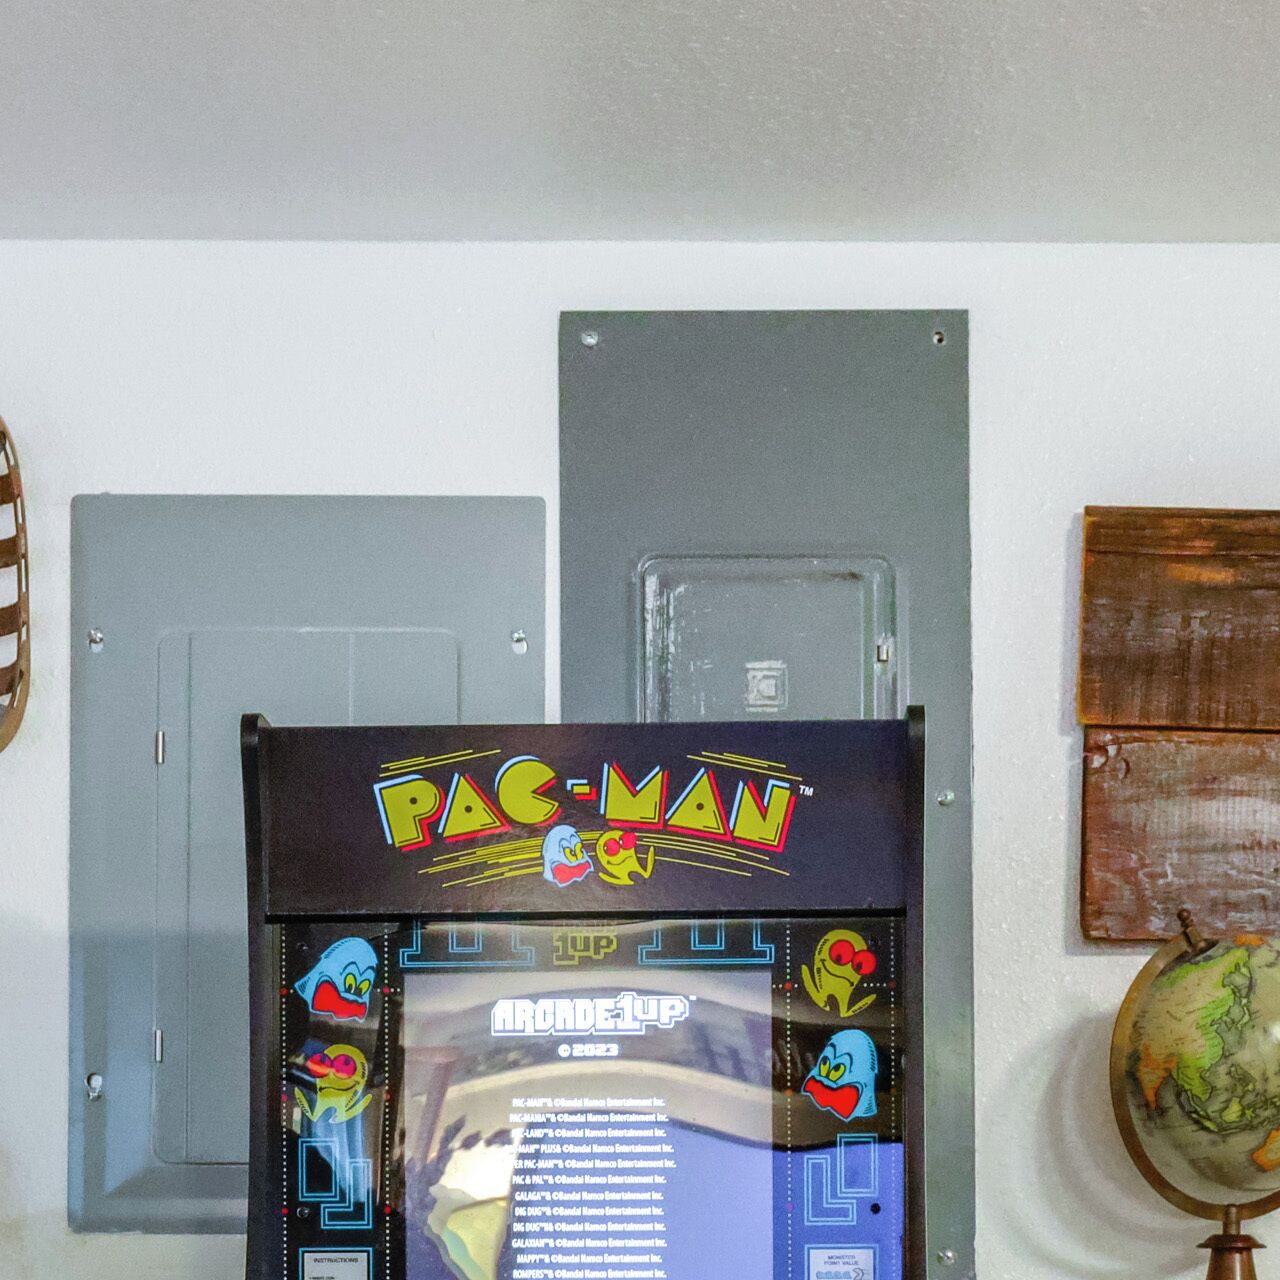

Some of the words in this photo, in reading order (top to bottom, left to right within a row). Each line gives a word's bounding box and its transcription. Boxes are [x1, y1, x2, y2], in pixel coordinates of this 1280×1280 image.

[373, 754, 797, 853] PAC-MAN
[572, 1044, 619, 1057] 2023
[584, 1098, 605, 1107] Namco
[607, 1097, 652, 1106] Entertainment
[587, 1113, 609, 1122] Namco
[610, 1112, 656, 1121] Entertainment
[585, 1128, 607, 1137] Namco
[608, 1127, 653, 1136] Entertainment
[593, 1144, 614, 1153] Namco
[615, 1143, 661, 1152] Entertainment
[595, 1159, 617, 1168] Namco
[618, 1158, 663, 1167] Entertainment
[585, 1175, 607, 1184] Namco
[608, 1174, 653, 1183] Entertainment
[582, 1191, 604, 1200] Namco
[605, 1190, 651, 1199] Entertainment
[582, 1207, 605, 1216] Namco
[605, 1206, 651, 1215] Entertainment
[585, 1222, 607, 1231] Namco
[608, 1221, 653, 1230] Entertainment
[586, 1238, 607, 1247] Namco
[608, 1237, 654, 1246] Entertainment
[581, 1254, 603, 1263] Namco
[604, 1253, 650, 1262] Entertainment
[585, 1269, 607, 1278] Namco
[608, 1268, 653, 1277] Entertainment
